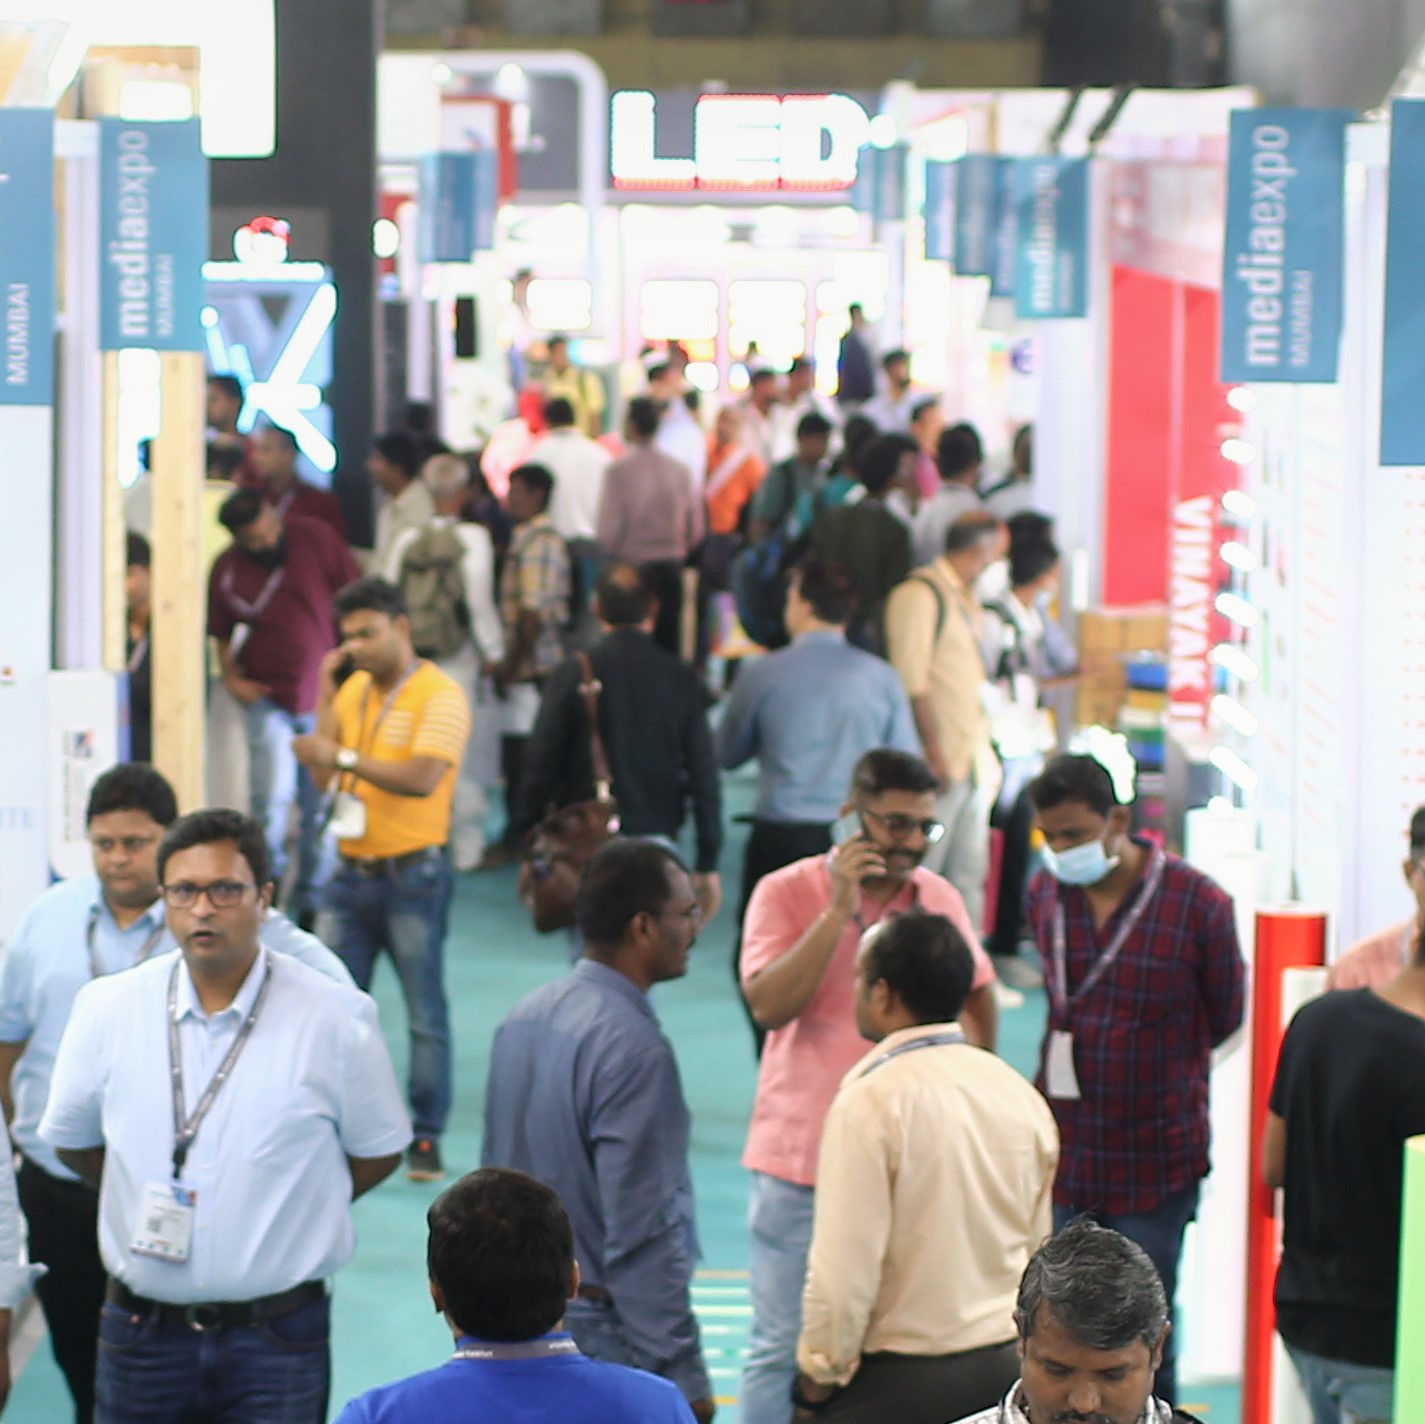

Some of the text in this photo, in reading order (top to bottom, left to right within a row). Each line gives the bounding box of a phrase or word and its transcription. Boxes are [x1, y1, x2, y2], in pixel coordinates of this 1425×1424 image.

[110, 129, 156, 338] mediaexpo
[610, 90, 870, 191] LED
[6, 283, 30, 385] MUMBAI
[1238, 123, 1297, 367] mediaexpo
[1172, 496, 1212, 690] VINAYAK
